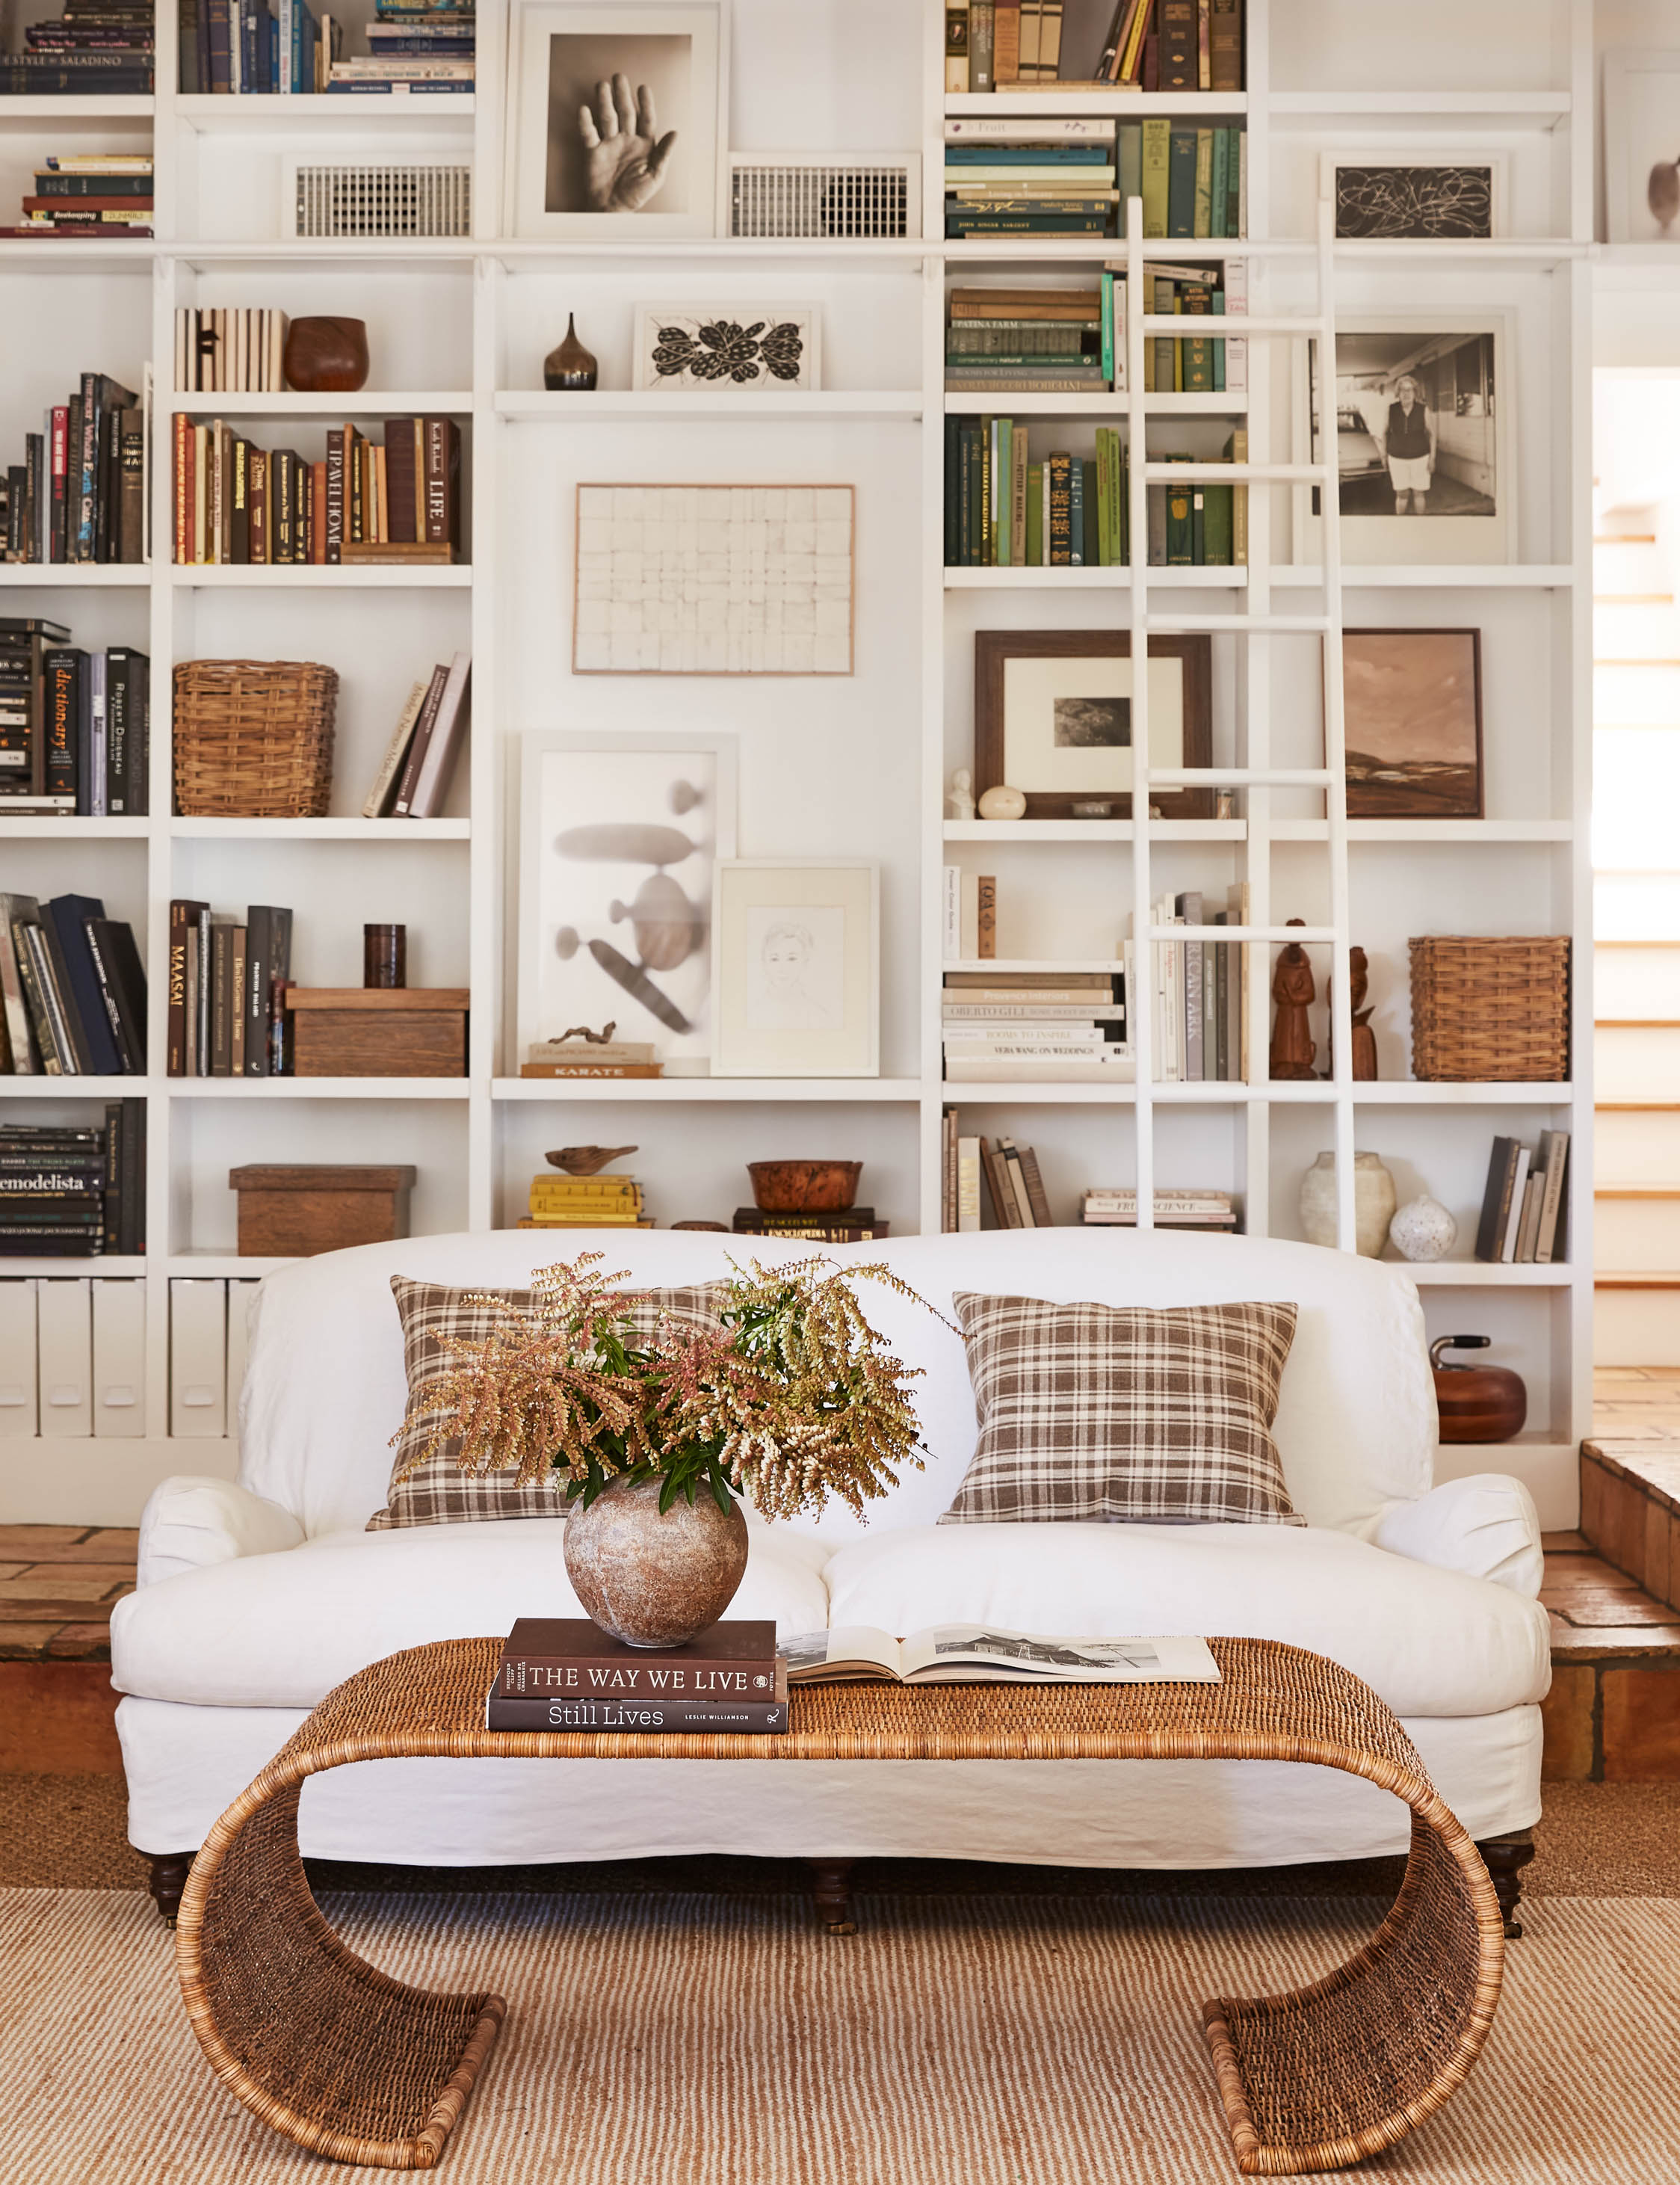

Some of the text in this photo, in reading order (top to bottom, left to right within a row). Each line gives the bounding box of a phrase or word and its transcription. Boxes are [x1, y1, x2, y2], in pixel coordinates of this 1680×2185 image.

[14, 55, 45, 66] STYLE
[60, 55, 122, 66] SALADINO
[957, 320, 989, 329] PATINA
[991, 321, 1019, 329] FARM
[83, 424, 95, 461] Whole
[81, 462, 94, 494] Earth
[329, 449, 343, 496] TRAVEL
[430, 480, 445, 518] LIFE
[1016, 463, 1024, 523] POTTERY MAKING
[114, 682, 126, 775] ROBERT DOISNEAU
[171, 946, 185, 1005] MAASAI
[950, 1008, 997, 1018] OBERTO
[1188, 1002, 1202, 1040] ARK
[986, 1031, 1018, 1040] ROOMS
[1022, 1031, 1036, 1040] TO
[994, 1046, 1095, 1055] VERA WANG ON WEDDINGS
[554, 1068, 626, 1077] KARATE
[0, 1173, 84, 1190] emodelista
[768, 1228, 827, 1239] ENCYCLOPEDIA
[517, 1662, 522, 1671] DE
[529, 1667, 747, 1691] THE WAY WE LIVE
[549, 1705, 664, 1726] Still Lives
